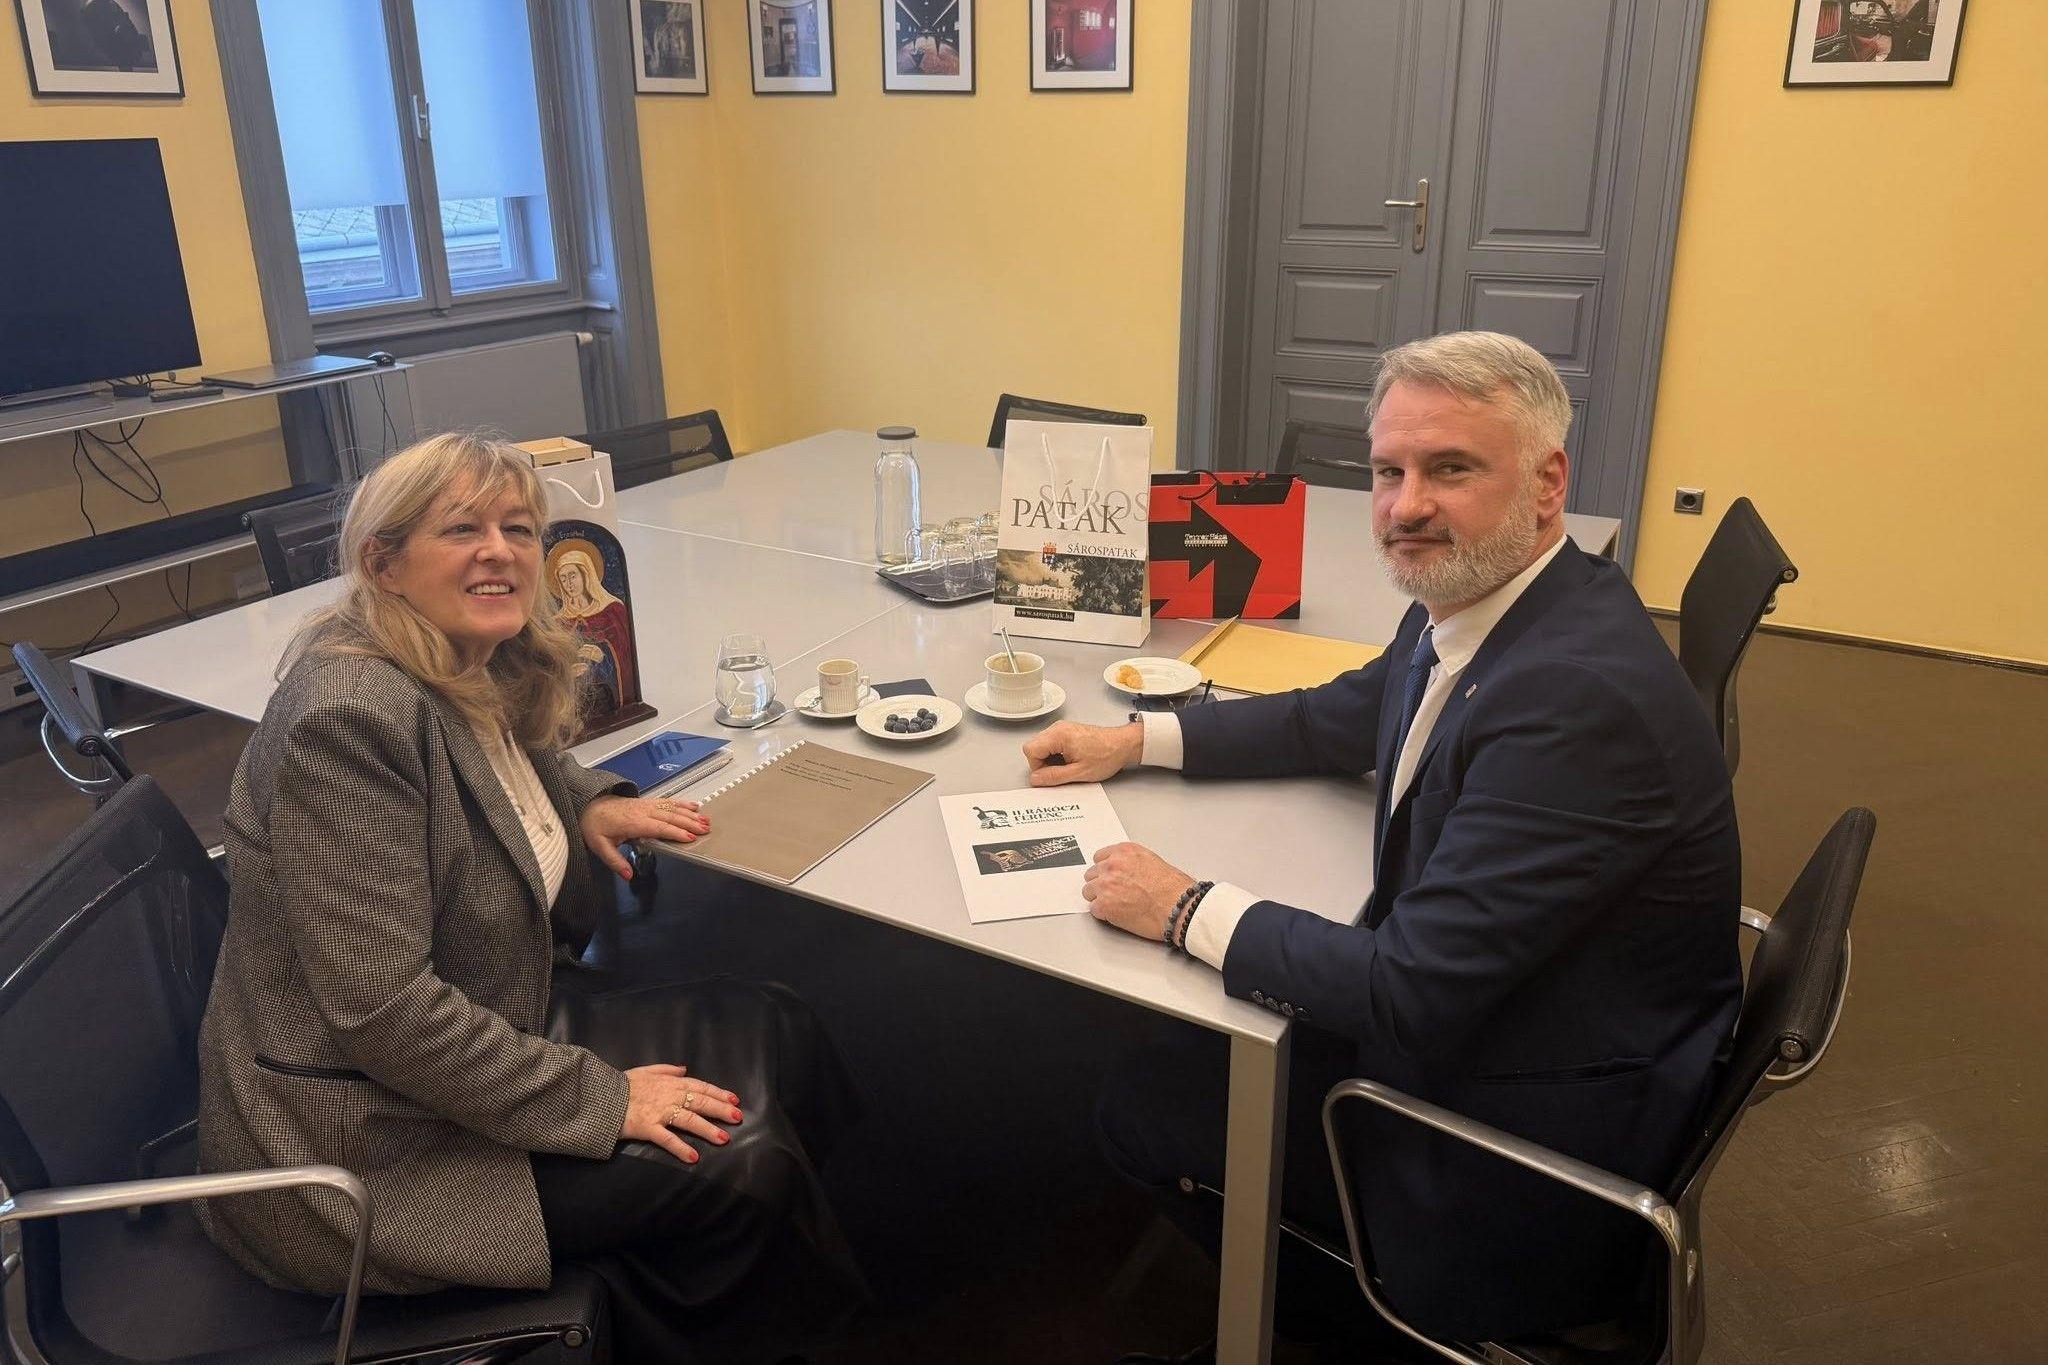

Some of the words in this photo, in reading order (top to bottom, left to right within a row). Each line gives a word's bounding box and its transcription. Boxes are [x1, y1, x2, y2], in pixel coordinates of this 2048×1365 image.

[1039, 480, 1147, 521] SÁROS
[1011, 498, 1126, 535] PATAK
[1066, 543, 1138, 558] SÁROSPATAK
[1014, 812, 1063, 821] FERENC
[1025, 804, 1080, 814] RÁKÓCZI
